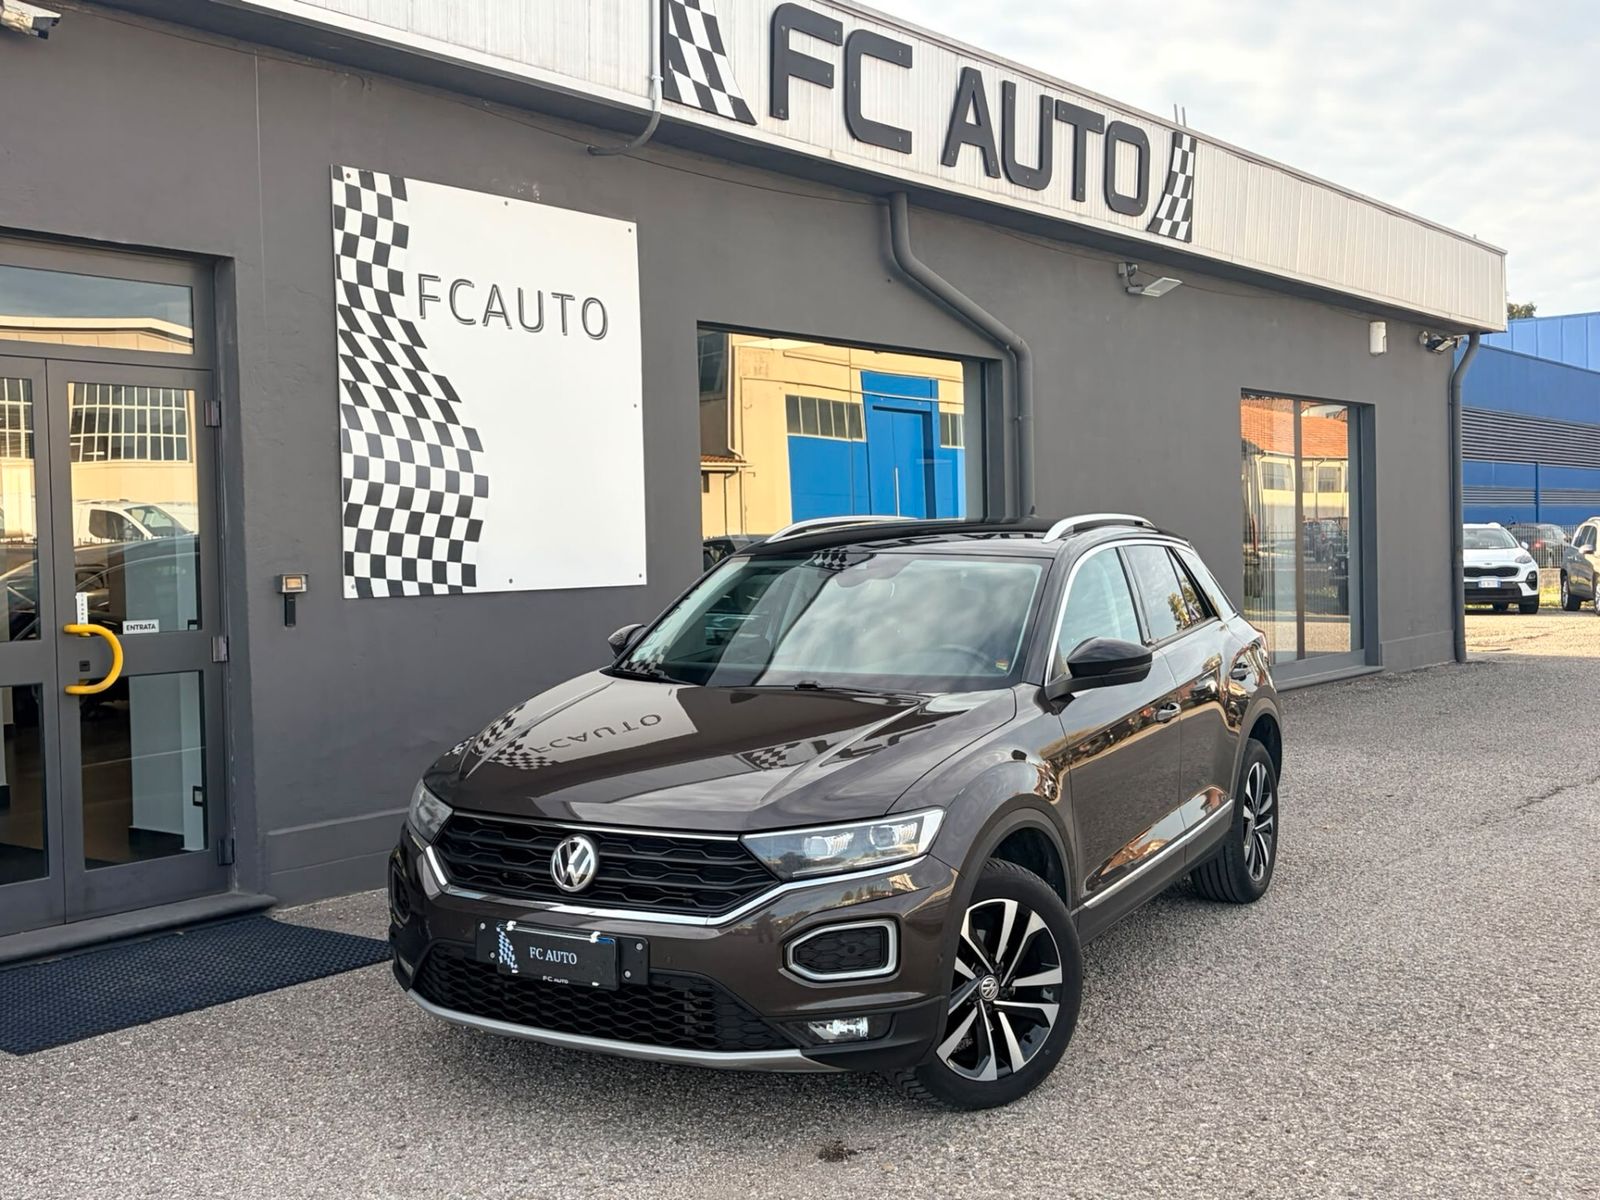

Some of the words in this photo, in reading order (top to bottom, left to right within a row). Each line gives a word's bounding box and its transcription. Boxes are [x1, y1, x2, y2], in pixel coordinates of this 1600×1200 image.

[769, 3, 913, 154] FC
[941, 66, 1151, 217] AUTO
[418, 273, 608, 340] FCAUTO
[126, 623, 156, 631] ENTRATA
[529, 946, 543, 960] FC
[545, 950, 577, 965] AUTO
